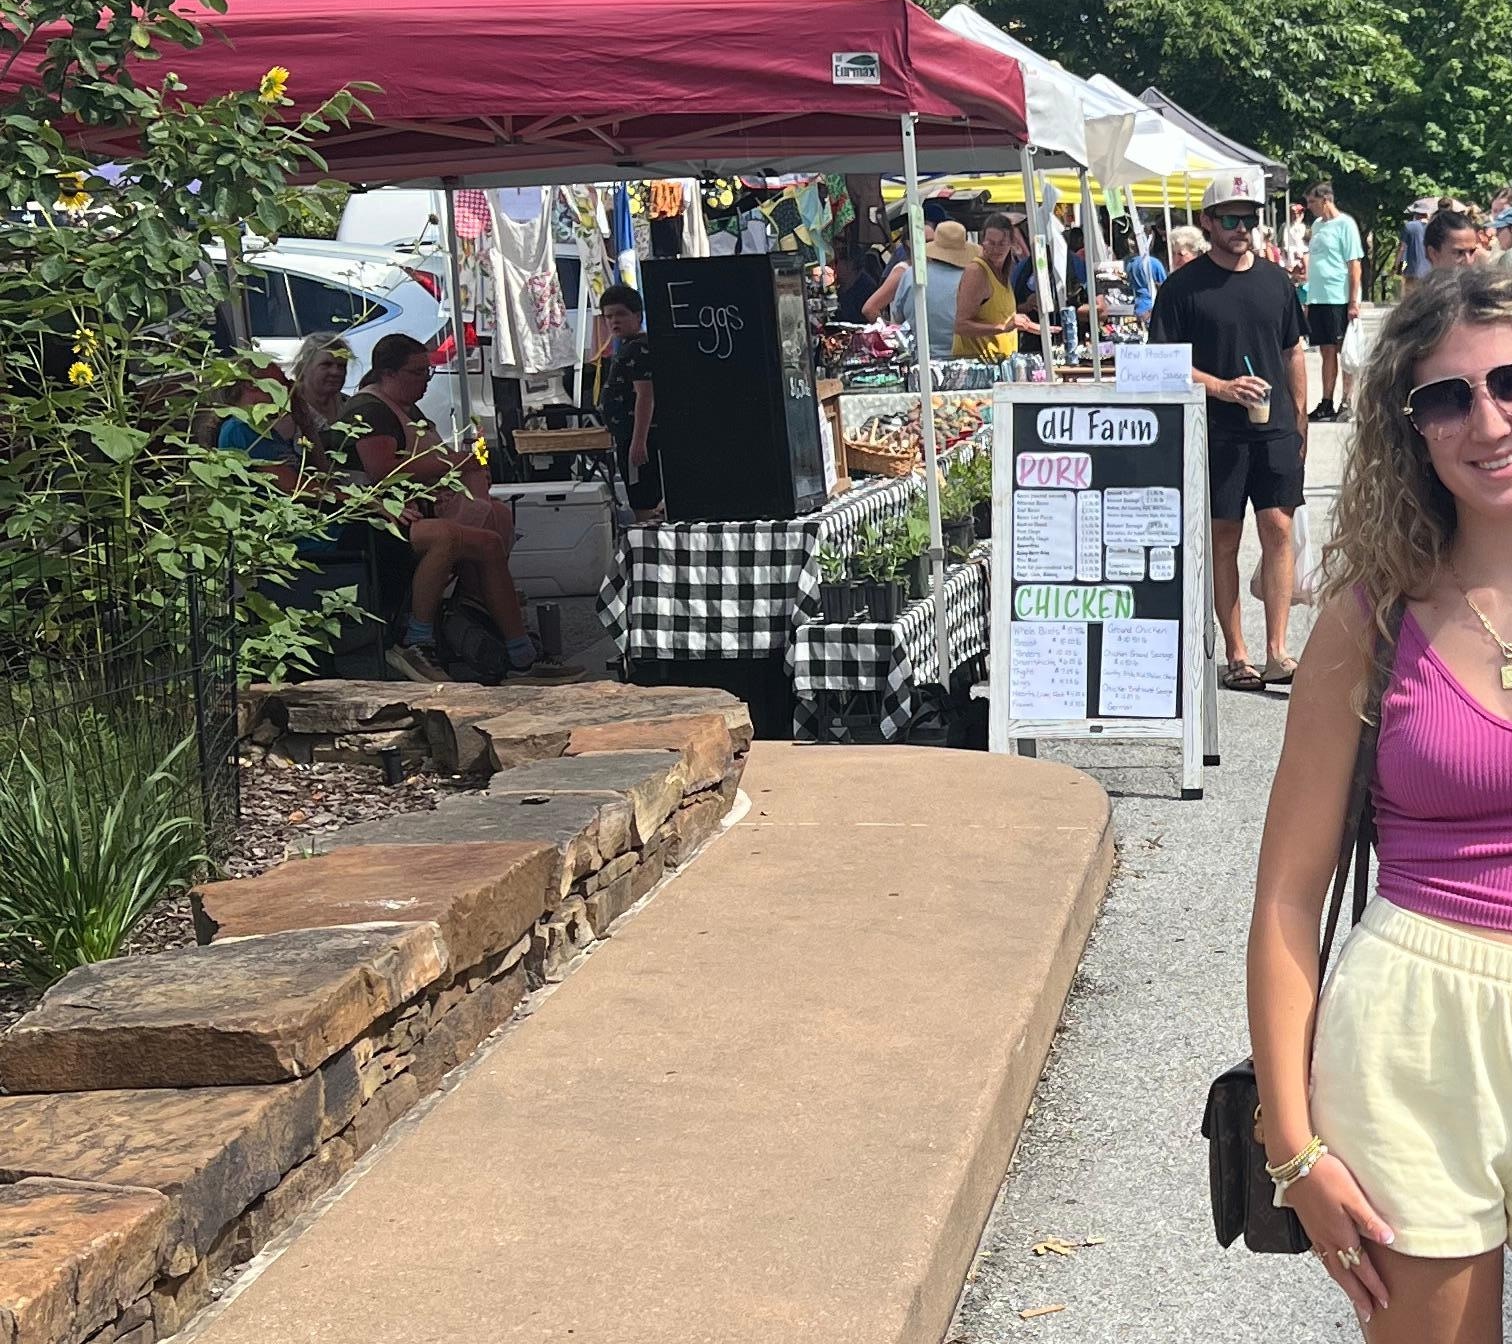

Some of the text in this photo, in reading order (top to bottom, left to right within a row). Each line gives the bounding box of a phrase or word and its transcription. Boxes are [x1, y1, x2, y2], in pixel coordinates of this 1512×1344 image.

[666, 280, 744, 360] Eggs
[1120, 347, 1140, 360] New
[1120, 367, 1159, 384] Chicken
[1042, 408, 1153, 441] dH Farm
[1019, 455, 1090, 487] PORK
[1017, 586, 1131, 619] CHICKEN
[1107, 623, 1168, 634] Ground Chicken
